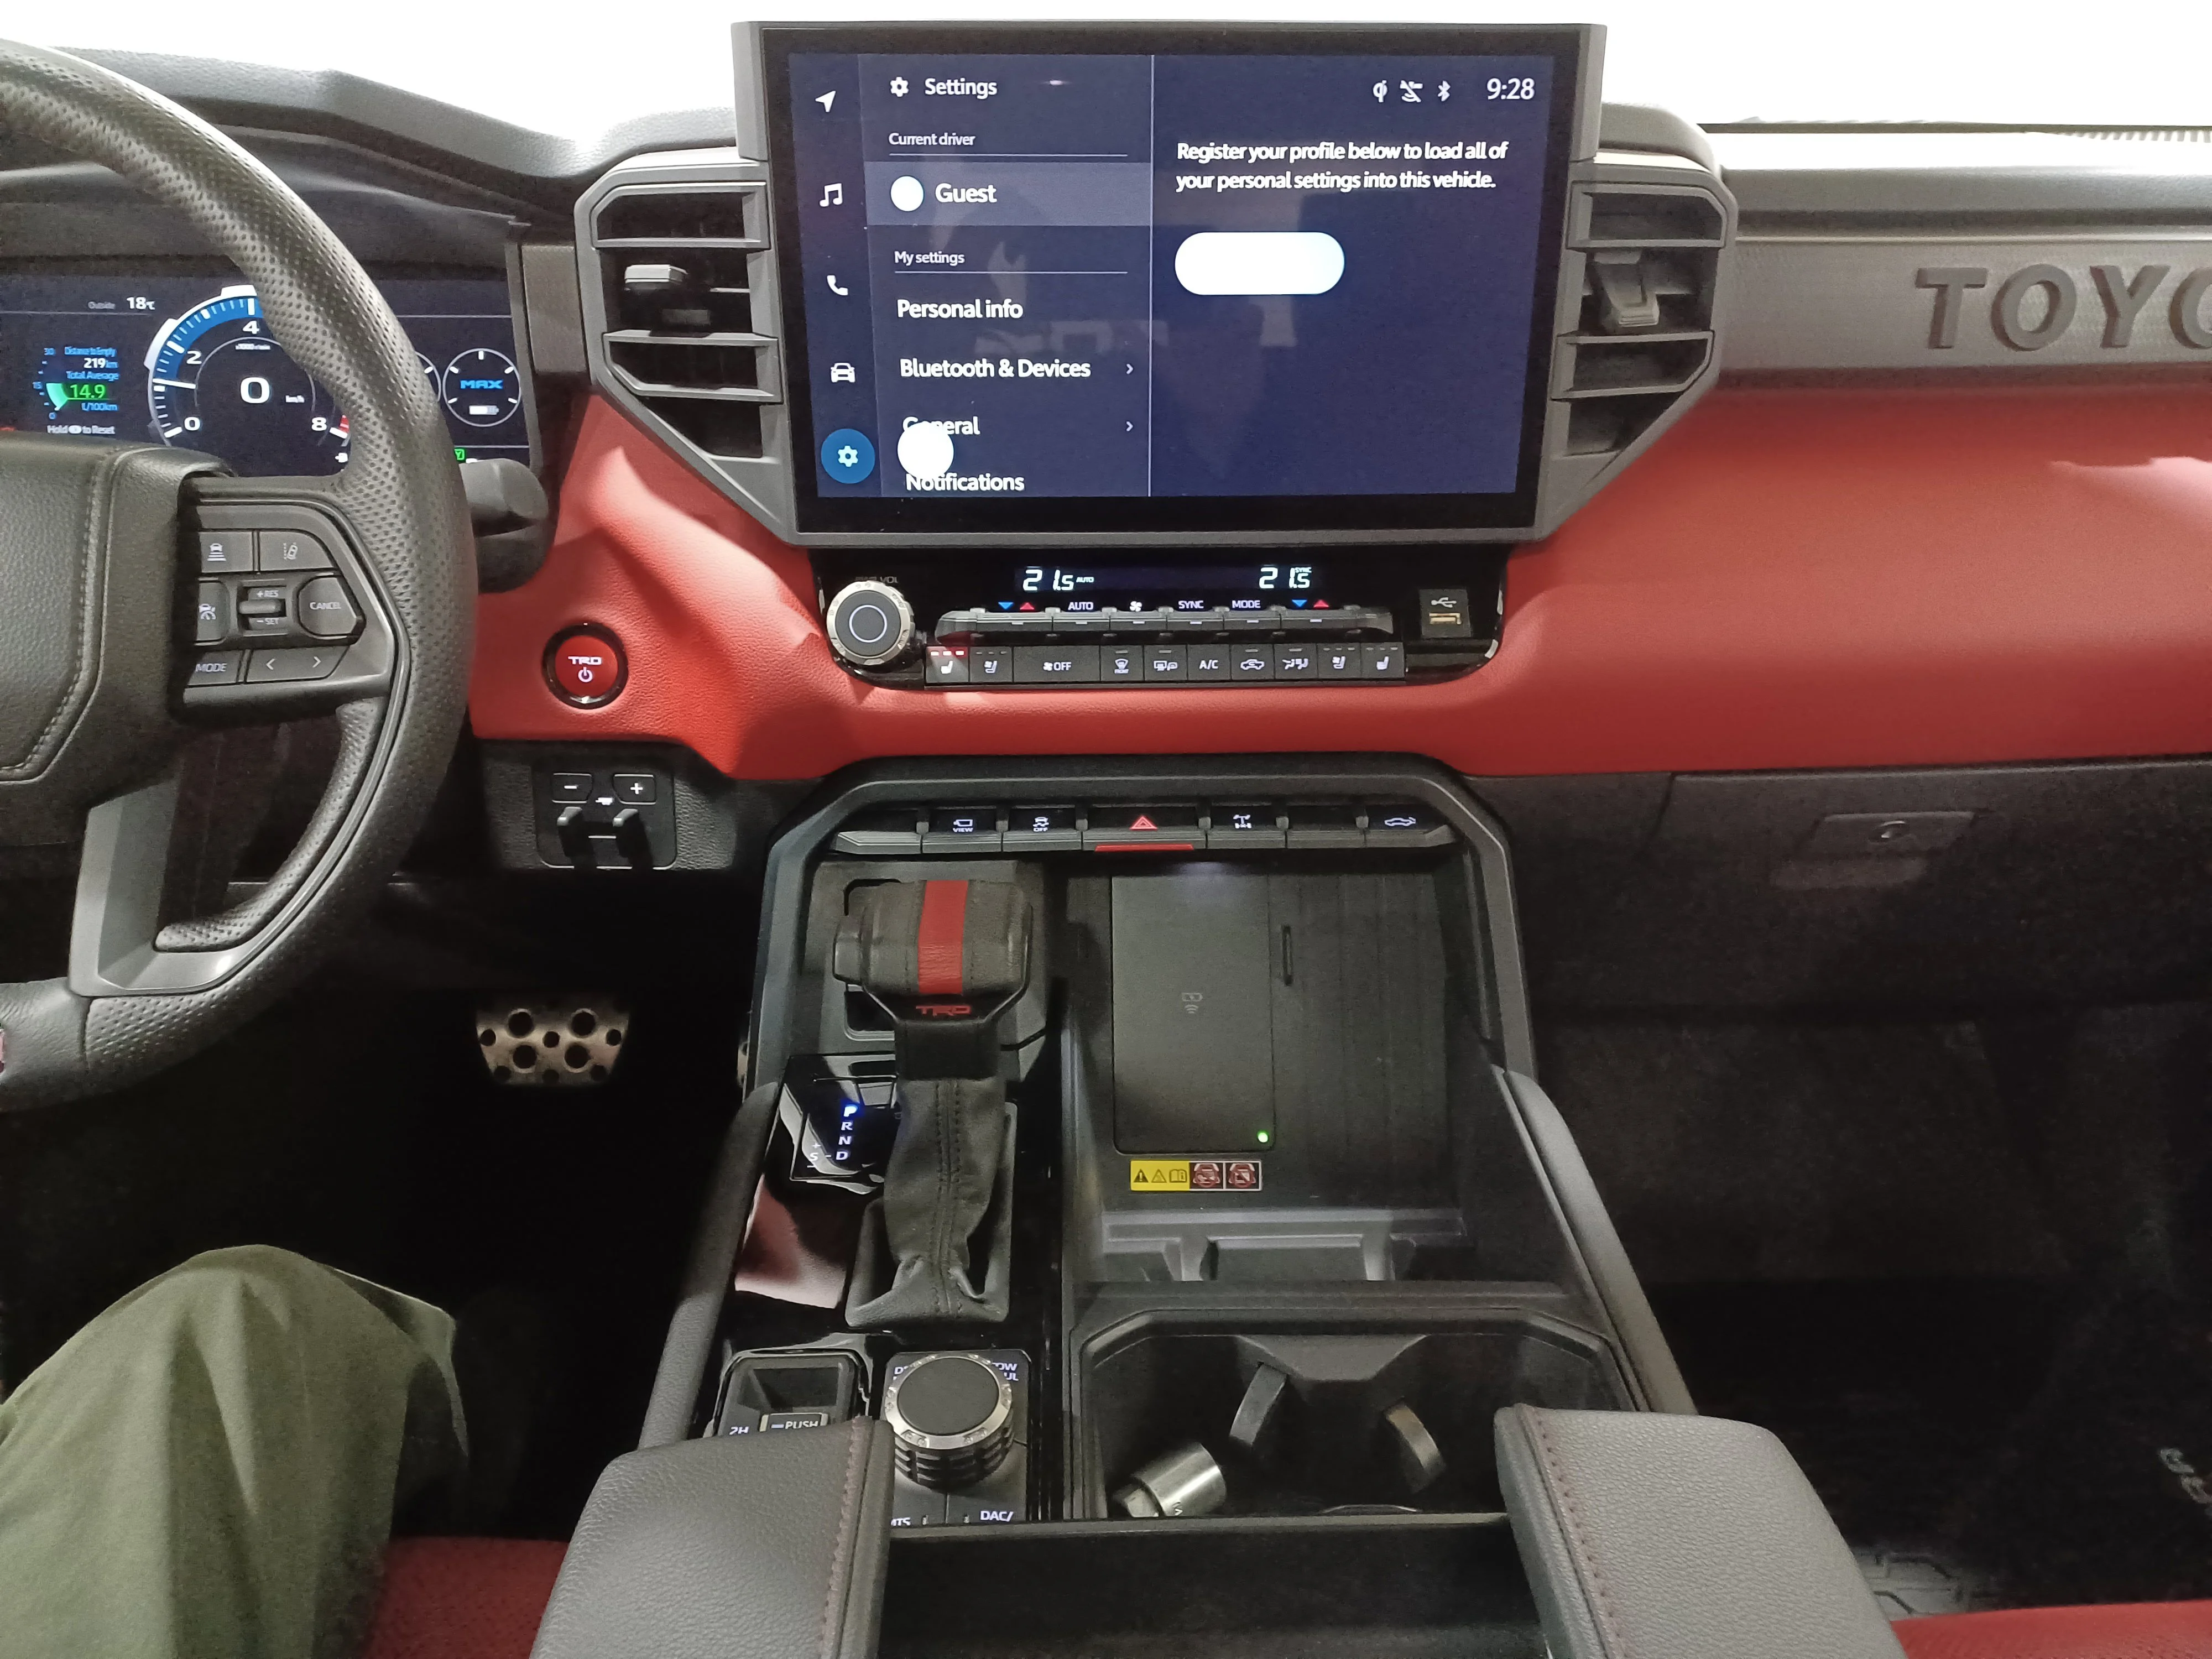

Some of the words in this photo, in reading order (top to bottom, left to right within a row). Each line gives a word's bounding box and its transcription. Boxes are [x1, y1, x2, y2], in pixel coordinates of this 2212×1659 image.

[925, 77, 998, 100] Settings
[1486, 77, 1535, 100] 9:28
[888, 132, 938, 145] Current
[938, 132, 976, 145] driver
[1177, 142, 1247, 163] Register
[1248, 146, 1288, 164] your
[1289, 141, 1346, 164] profile
[1348, 142, 1402, 159] below
[1403, 143, 1422, 159] to
[1425, 142, 1463, 159] load
[1464, 142, 1488, 159] all
[1488, 141, 1509, 159] of
[1176, 175, 1215, 192] your
[1217, 171, 1292, 192] personal
[1293, 171, 1361, 192] settings
[1363, 171, 1398, 189] into
[1399, 170, 1431, 188] this
[1432, 170, 1496, 188] vehicle.
[935, 182, 998, 203] Guest
[894, 251, 914, 266] My
[915, 251, 965, 267] settings
[897, 299, 983, 319] Personal
[985, 298, 1024, 319] info
[242, 321, 260, 334] 4
[84, 357, 106, 369] 219
[186, 350, 202, 364] 2
[900, 358, 995, 378] Bluetooth
[998, 358, 1015, 378] &
[1018, 358, 1091, 378] Devices
[66, 371, 86, 380] Total
[86, 371, 119, 382] Average
[240, 377, 270, 404] 0
[460, 380, 503, 389] MAX
[70, 384, 106, 399] 14.9
[184, 416, 201, 431] 0
[311, 417, 327, 431] 8
[902, 416, 981, 435] Geral
[906, 473, 1025, 491] Notifications
[309, 602, 341, 610] CANCEL
[1067, 601, 1094, 611] AUTO
[1178, 600, 1204, 609] SYNC
[1232, 599, 1261, 609] MODE
[567, 656, 602, 665] TRD
[1053, 662, 1072, 671] OFF
[1199, 659, 1218, 670] A/C
[195, 662, 227, 672] MODE
[916, 1004, 972, 1016] TRD
[843, 1105, 858, 1117] P
[841, 1121, 853, 1131] R
[838, 1136, 852, 1145] N
[836, 1151, 849, 1160] D
[785, 1420, 819, 1430] PUSH
